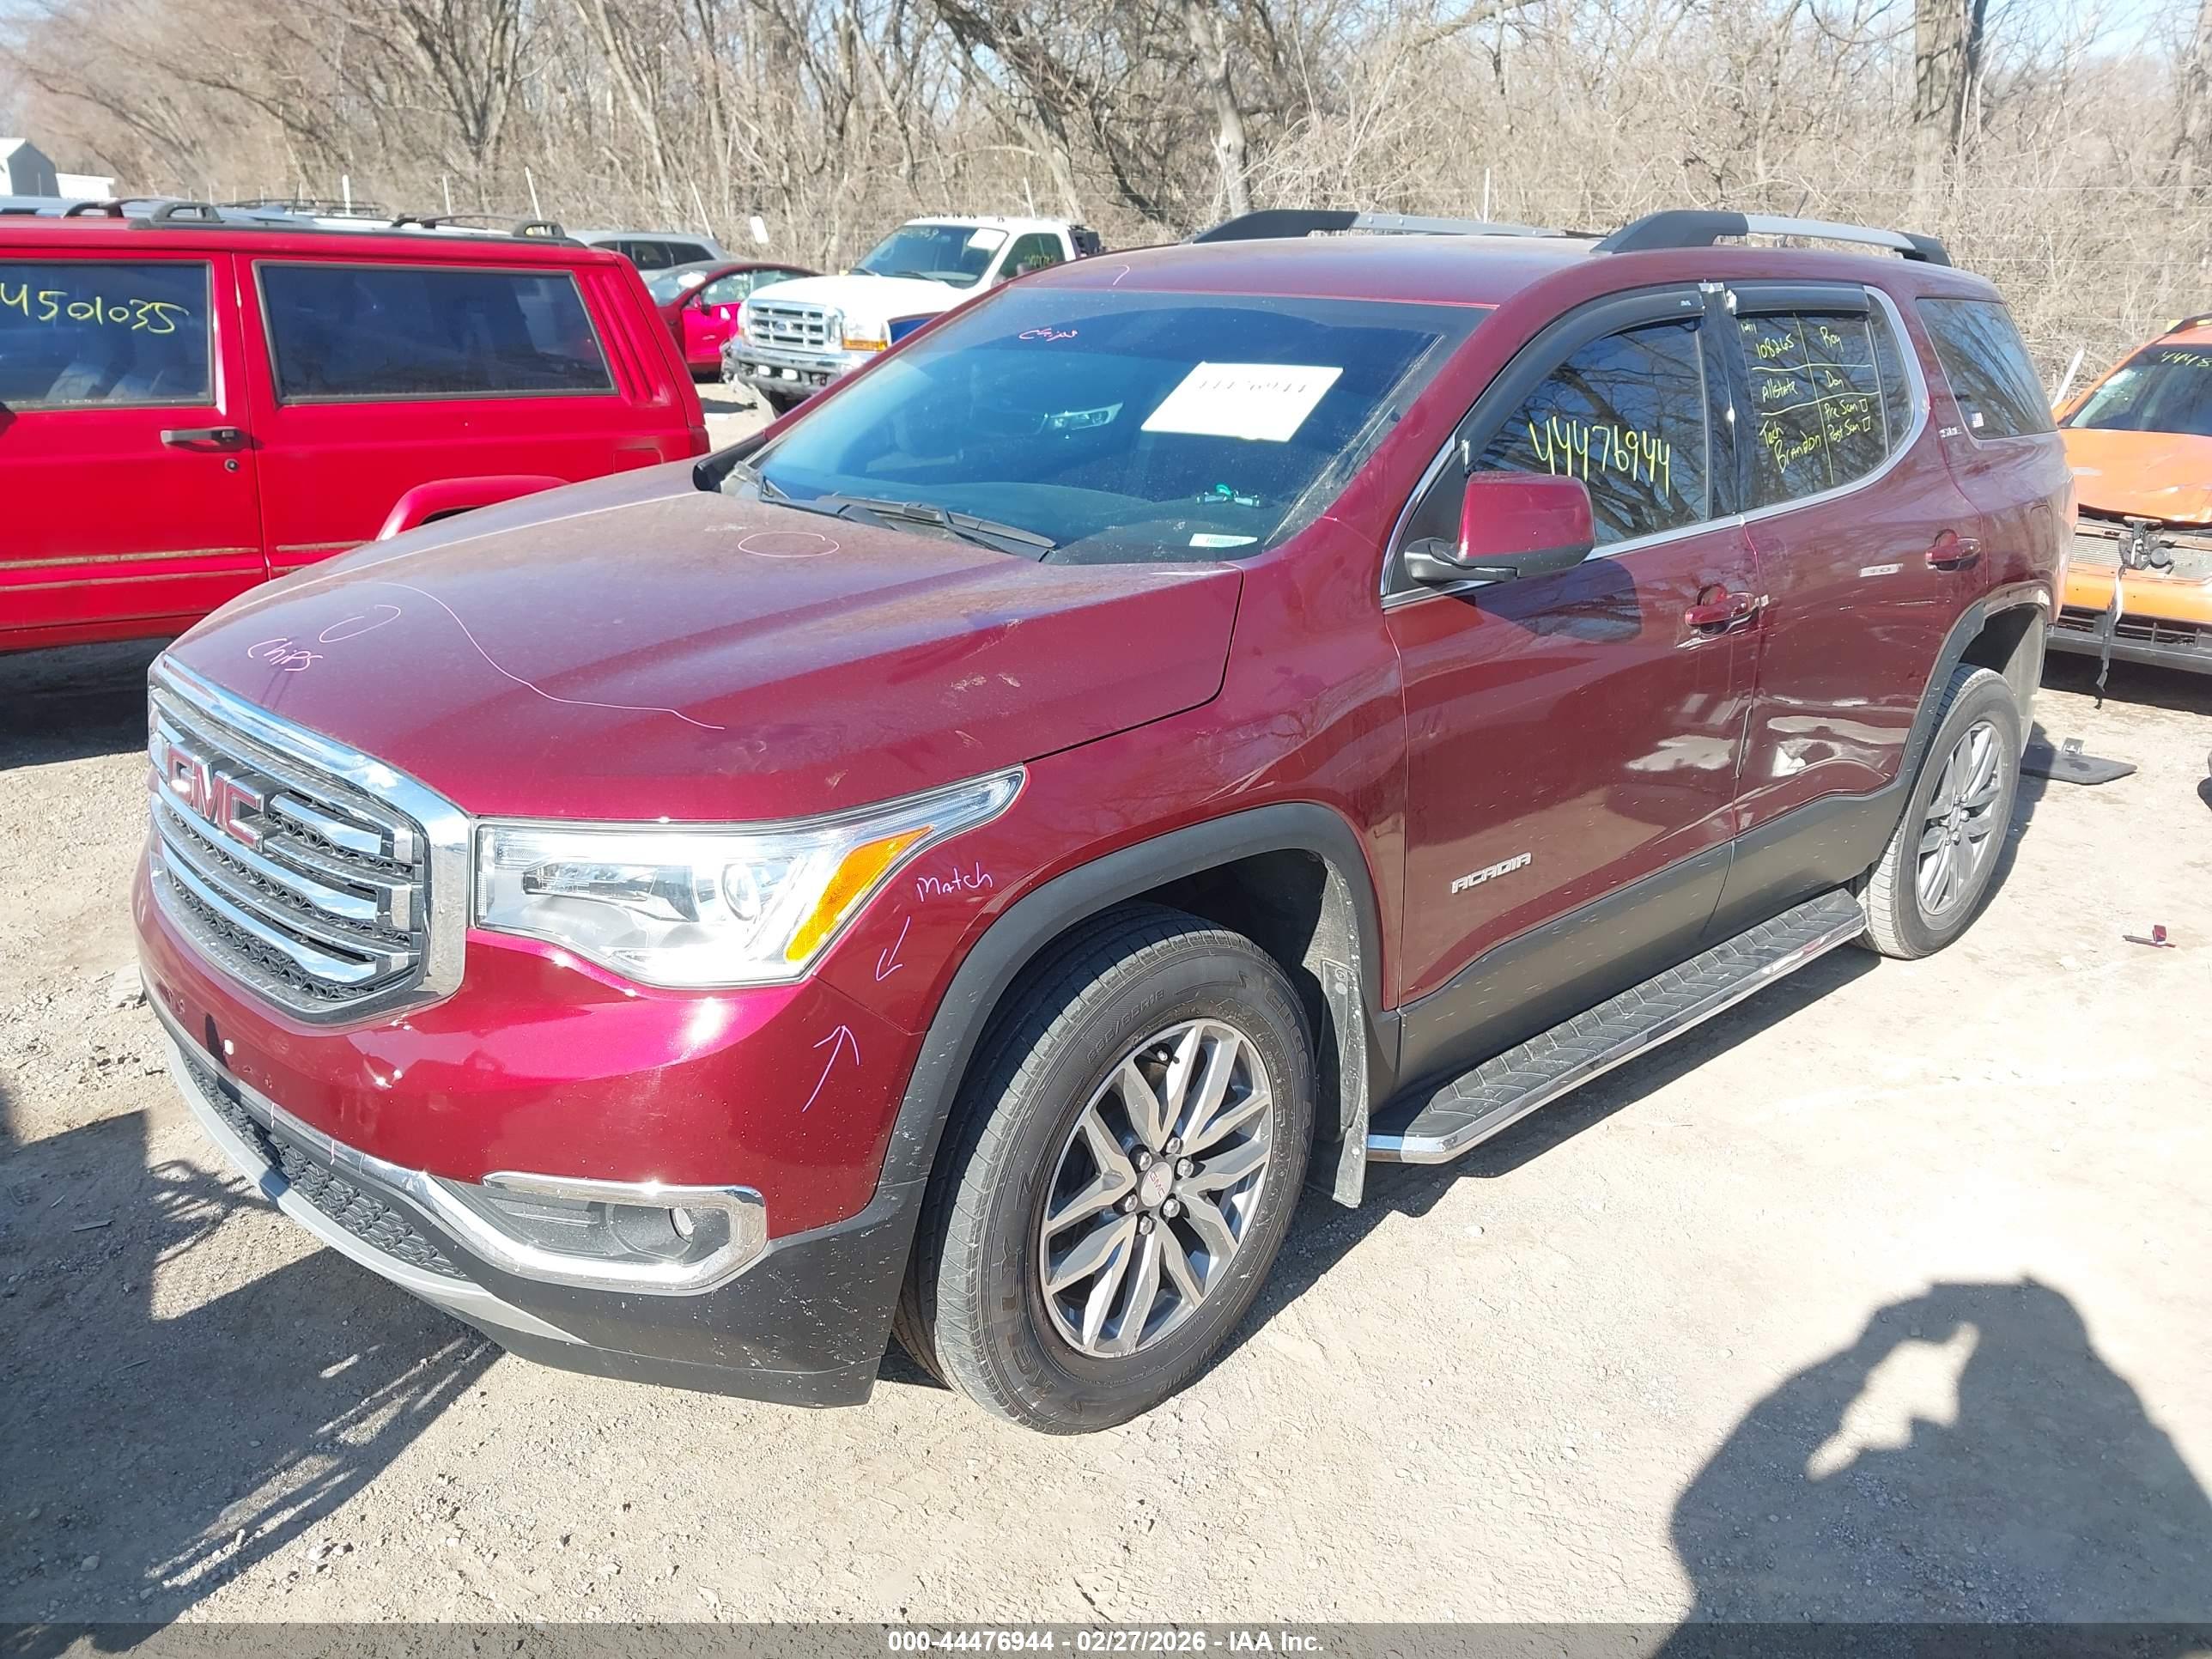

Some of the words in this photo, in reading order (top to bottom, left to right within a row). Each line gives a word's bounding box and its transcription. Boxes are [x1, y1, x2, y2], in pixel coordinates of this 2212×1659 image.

[1755, 332, 1795, 360] 108265
[1528, 416, 1670, 498] 44476944
[167, 745, 265, 853] GMC
[1451, 852, 1532, 895] ACADIA
